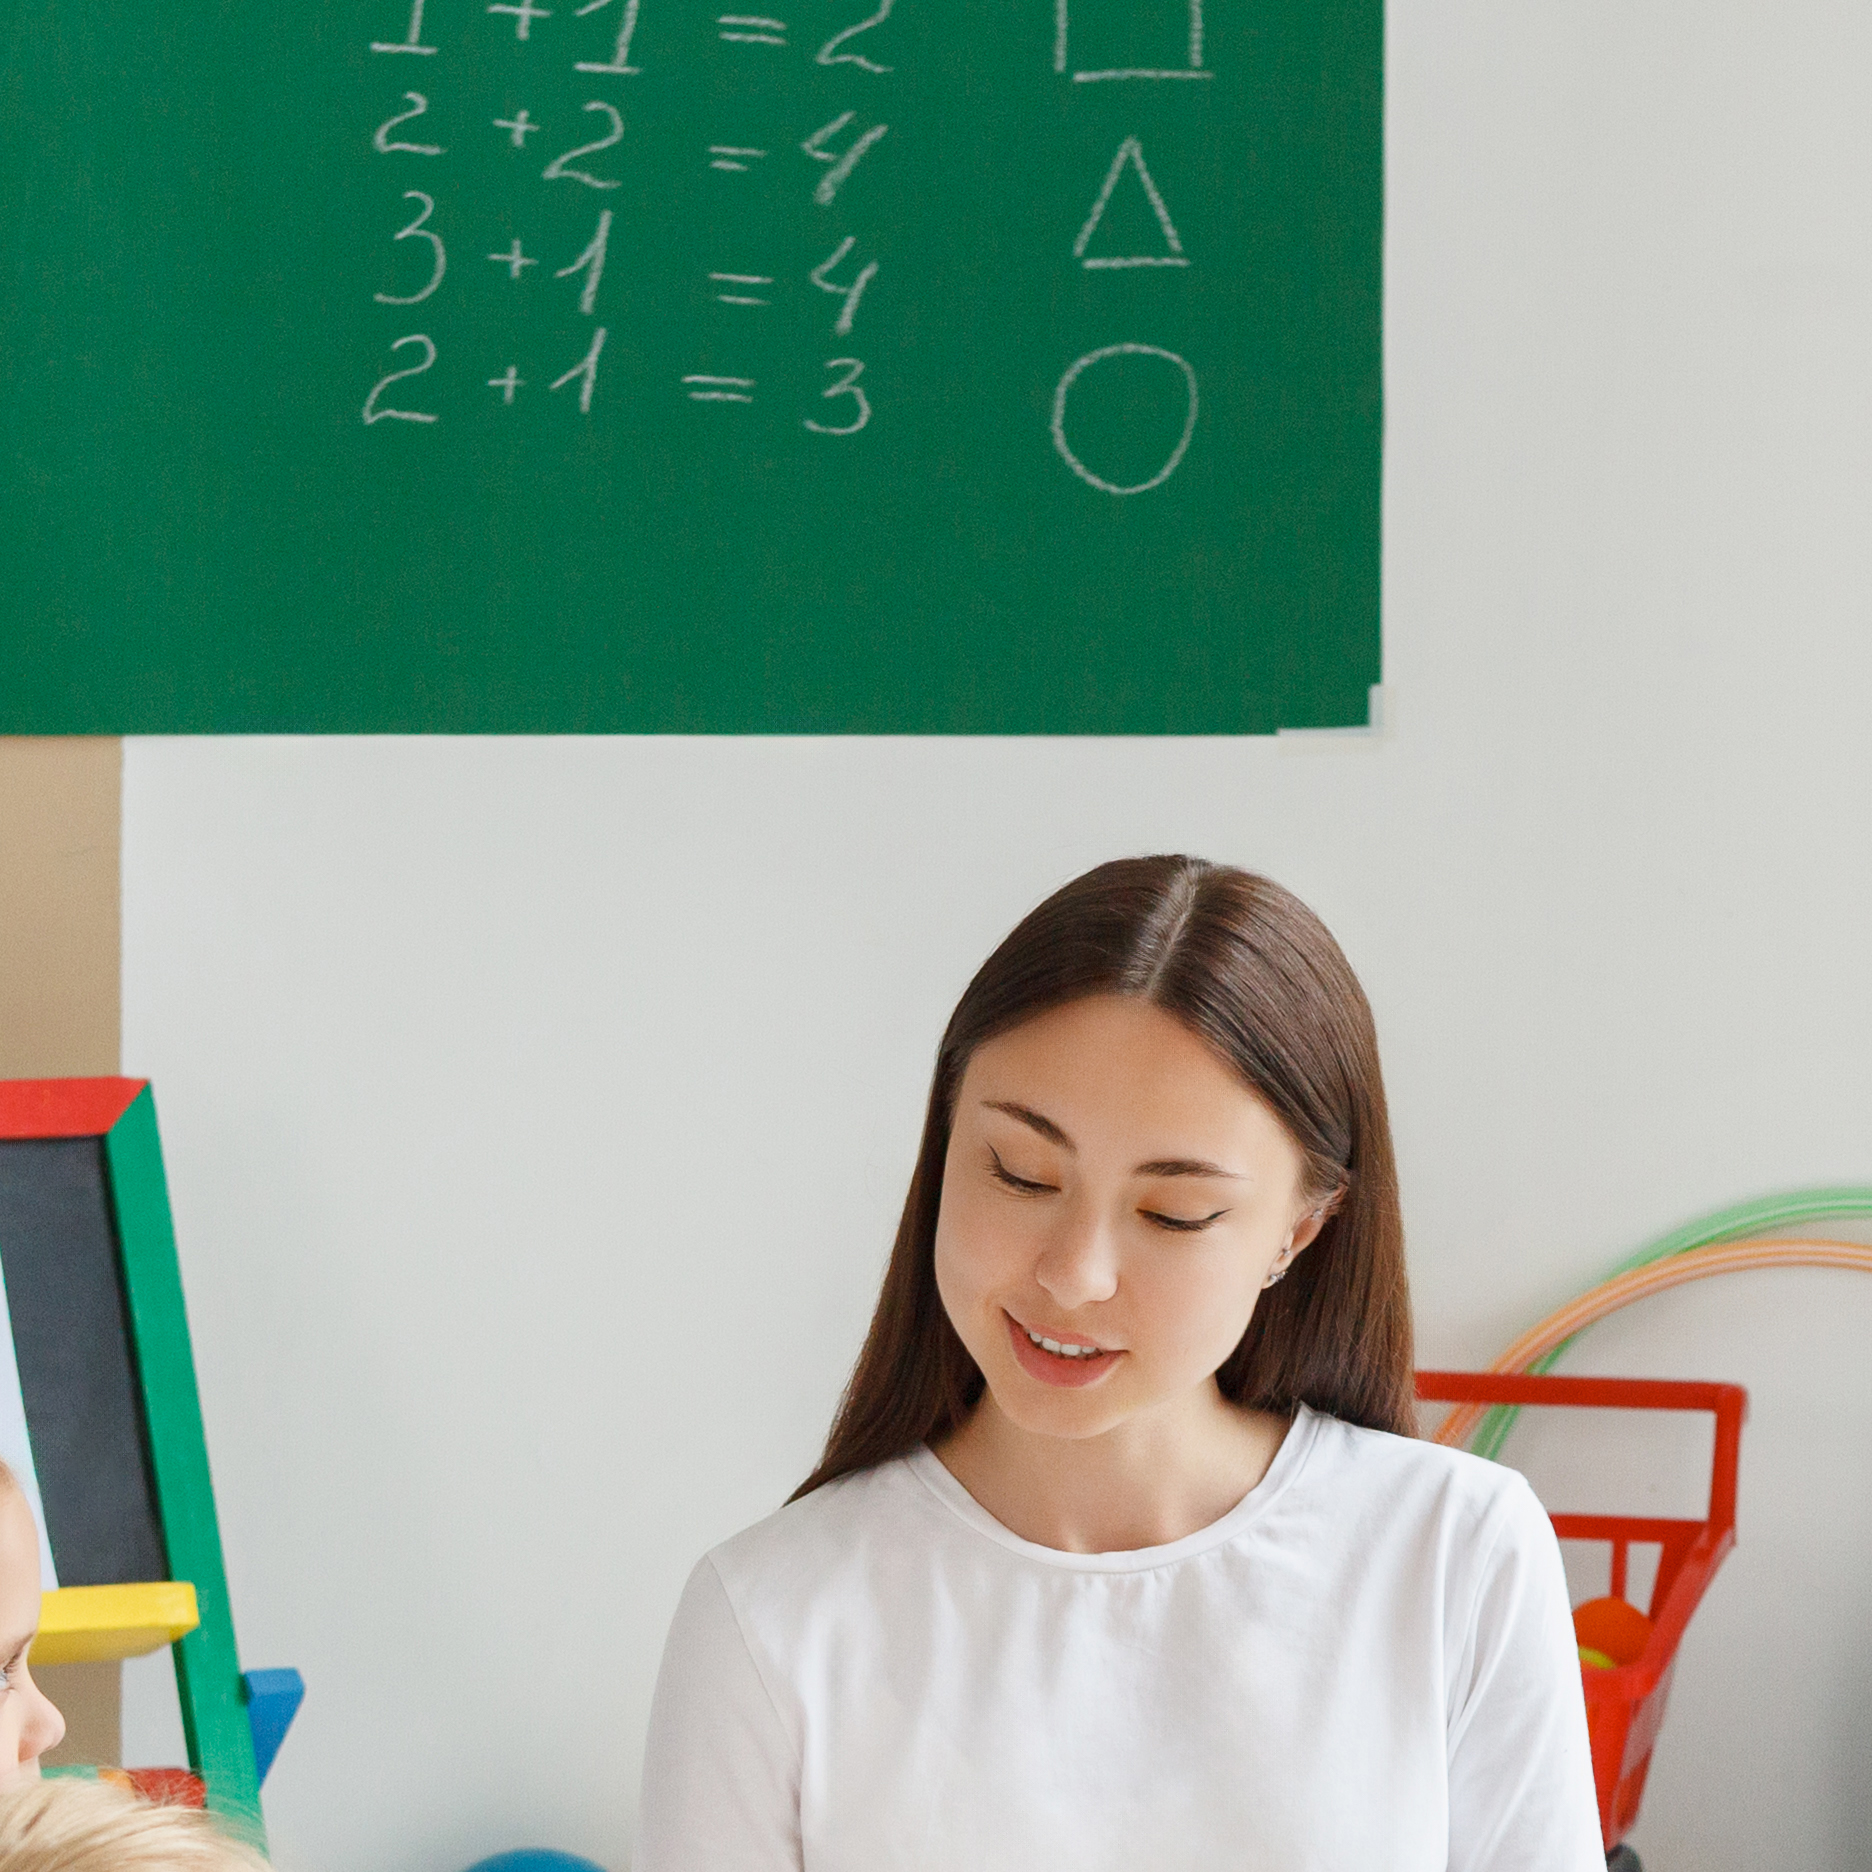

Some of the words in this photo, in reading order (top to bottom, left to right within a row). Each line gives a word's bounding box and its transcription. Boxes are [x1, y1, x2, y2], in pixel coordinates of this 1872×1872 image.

[374, 91, 444, 155] 2
[543, 100, 624, 189] 2
[801, 111, 888, 204] 4
[374, 190, 447, 305] 3
[810, 236, 878, 335] 4
[362, 333, 438, 425] 2
[803, 357, 872, 436] 3
